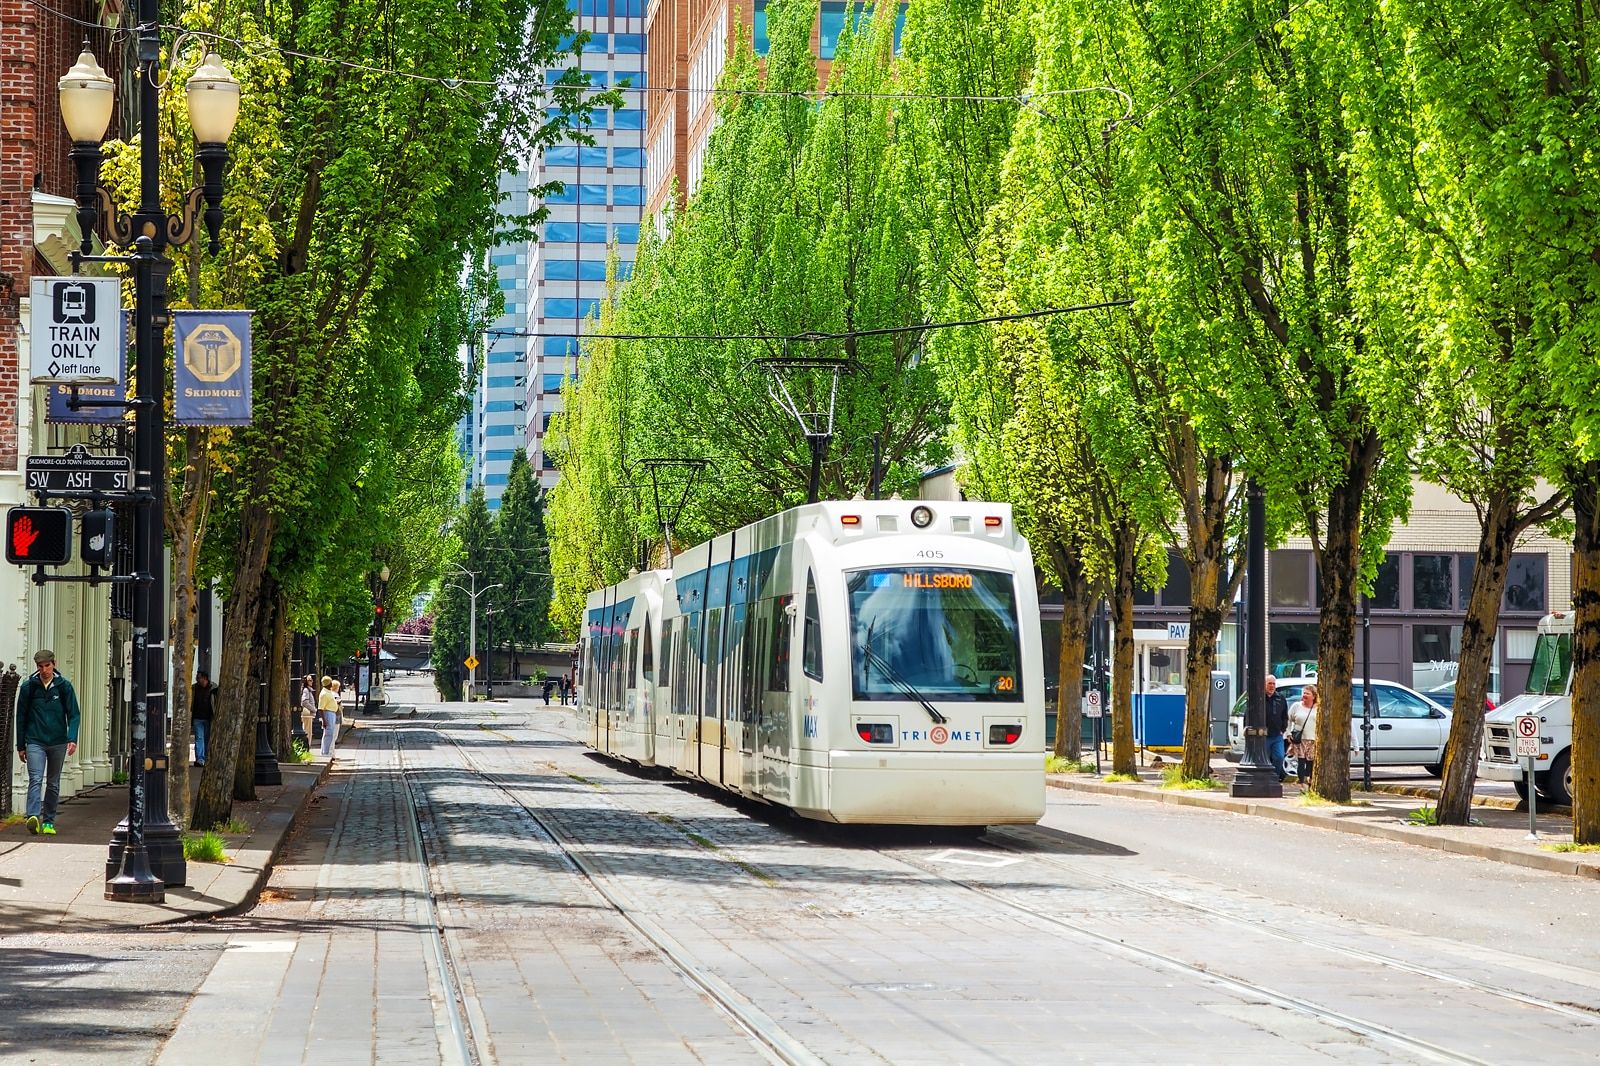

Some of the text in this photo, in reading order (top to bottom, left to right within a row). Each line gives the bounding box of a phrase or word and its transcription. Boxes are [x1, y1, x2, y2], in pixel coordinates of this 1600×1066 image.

[49, 327, 100, 341] TRAIN
[51, 343, 96, 358] ONLY
[61, 363, 101, 374] left lane
[58, 384, 116, 397] SKDMORE
[29, 471, 128, 488] SW ASH ST
[916, 550, 944, 559] 405
[903, 573, 973, 588] HILLSBORO
[1170, 625, 1187, 639] PAY
[998, 676, 1013, 690] 20
[803, 714, 818, 738] MAX
[902, 731, 982, 741] TRI MET
[1518, 746, 1538, 754] BLOCK
